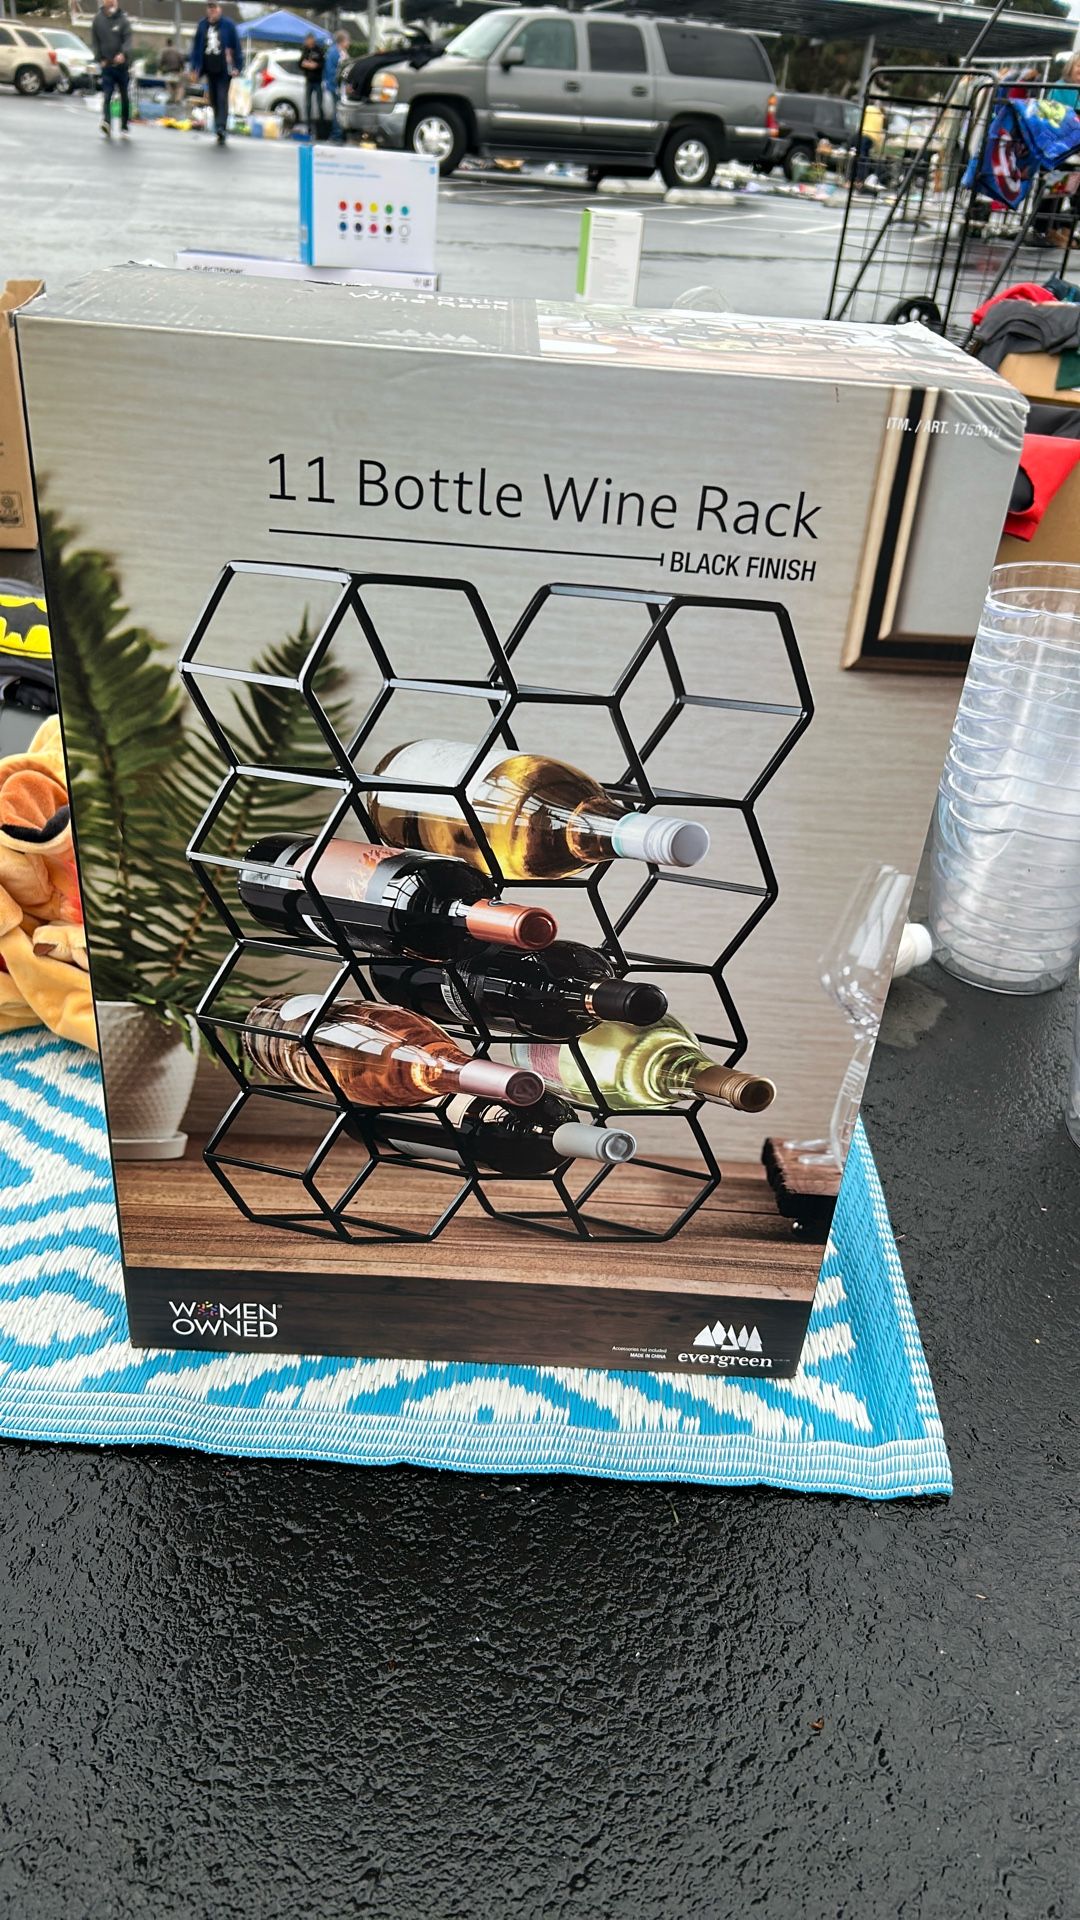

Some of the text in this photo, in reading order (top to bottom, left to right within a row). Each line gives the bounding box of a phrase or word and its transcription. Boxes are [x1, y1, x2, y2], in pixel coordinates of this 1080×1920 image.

[349, 291, 509, 311] Wine Rack
[886, 417, 912, 432] ITM.
[268, 453, 823, 539] 11 Bottle Wine Rack
[670, 552, 816, 582] BLACK FINISH
[172, 1318, 278, 1338] OWNED
[678, 1352, 773, 1368] evergreen
